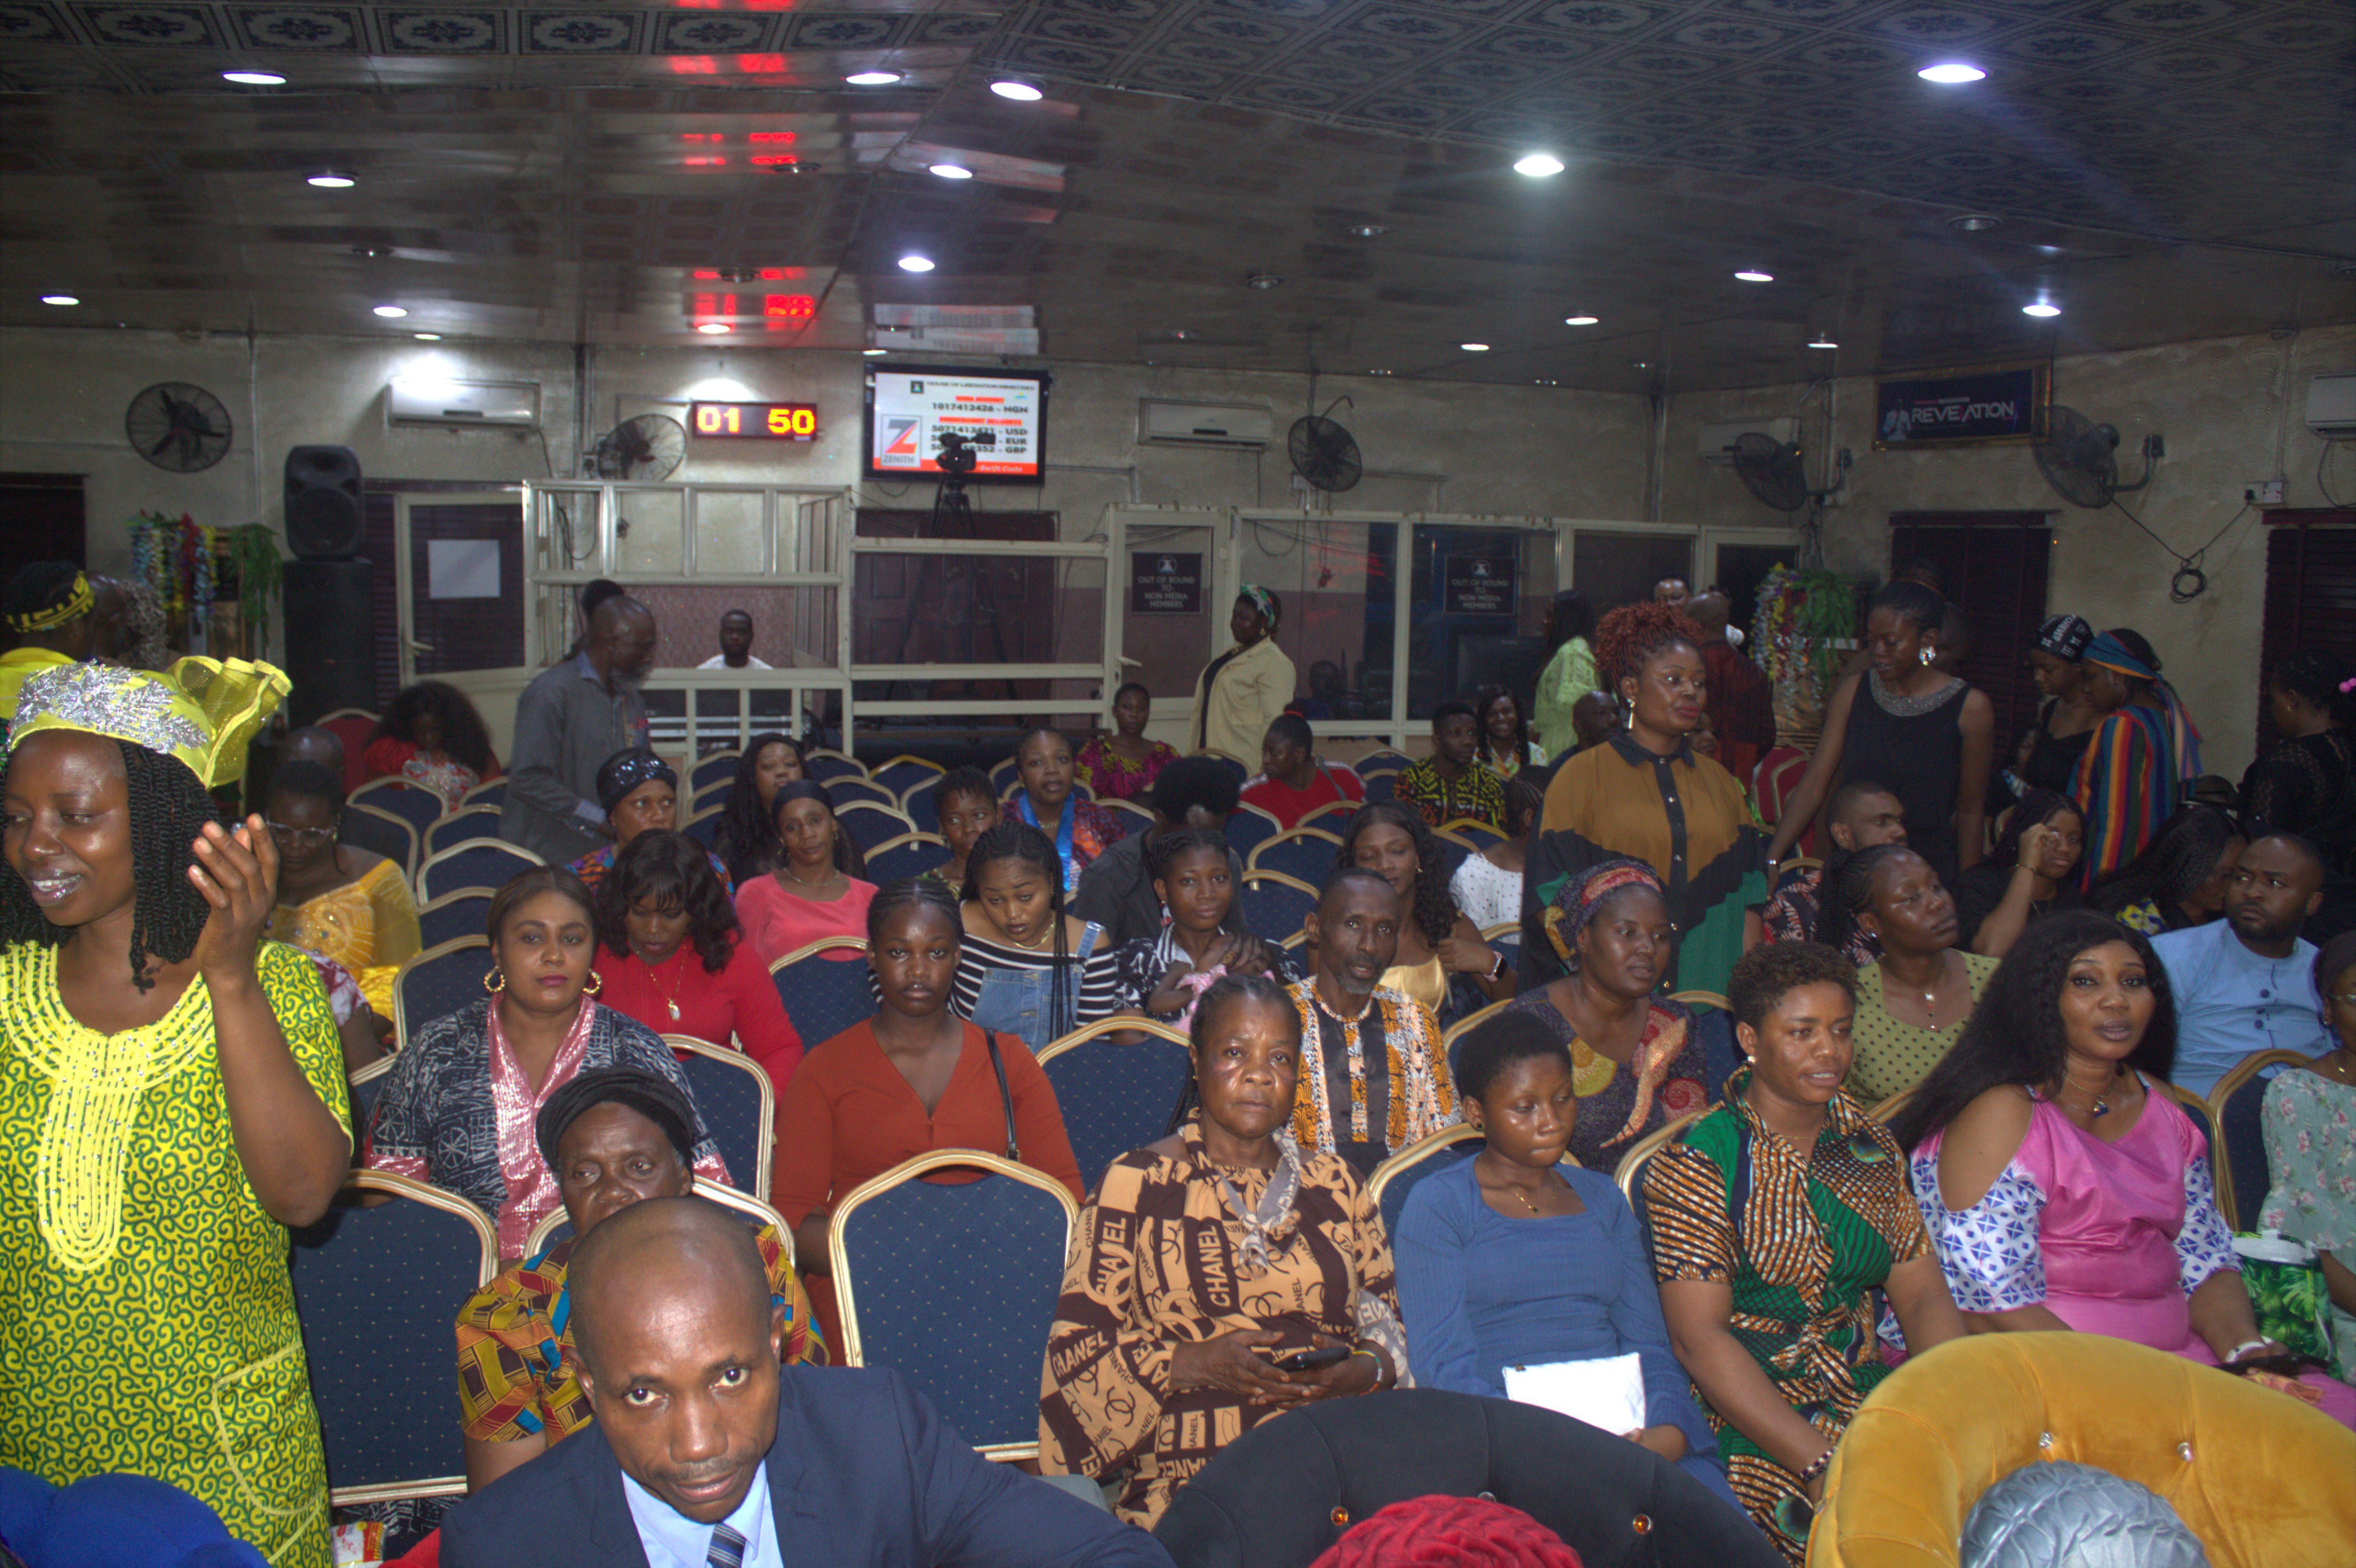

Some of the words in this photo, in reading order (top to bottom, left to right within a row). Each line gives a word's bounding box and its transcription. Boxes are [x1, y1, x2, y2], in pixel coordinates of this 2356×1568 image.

[697, 407, 740, 433] 01
[768, 408, 816, 435] 50
[931, 402, 994, 412] 1017412426
[1911, 401, 2014, 423] REVEATION
[883, 455, 914, 463] ZENITH
[1096, 1217, 1127, 1296] CHAEL
[1197, 1225, 1231, 1308] CHANEL
[1052, 1331, 1109, 1379] CHANEL
[1107, 1350, 1137, 1385] CHANEL
